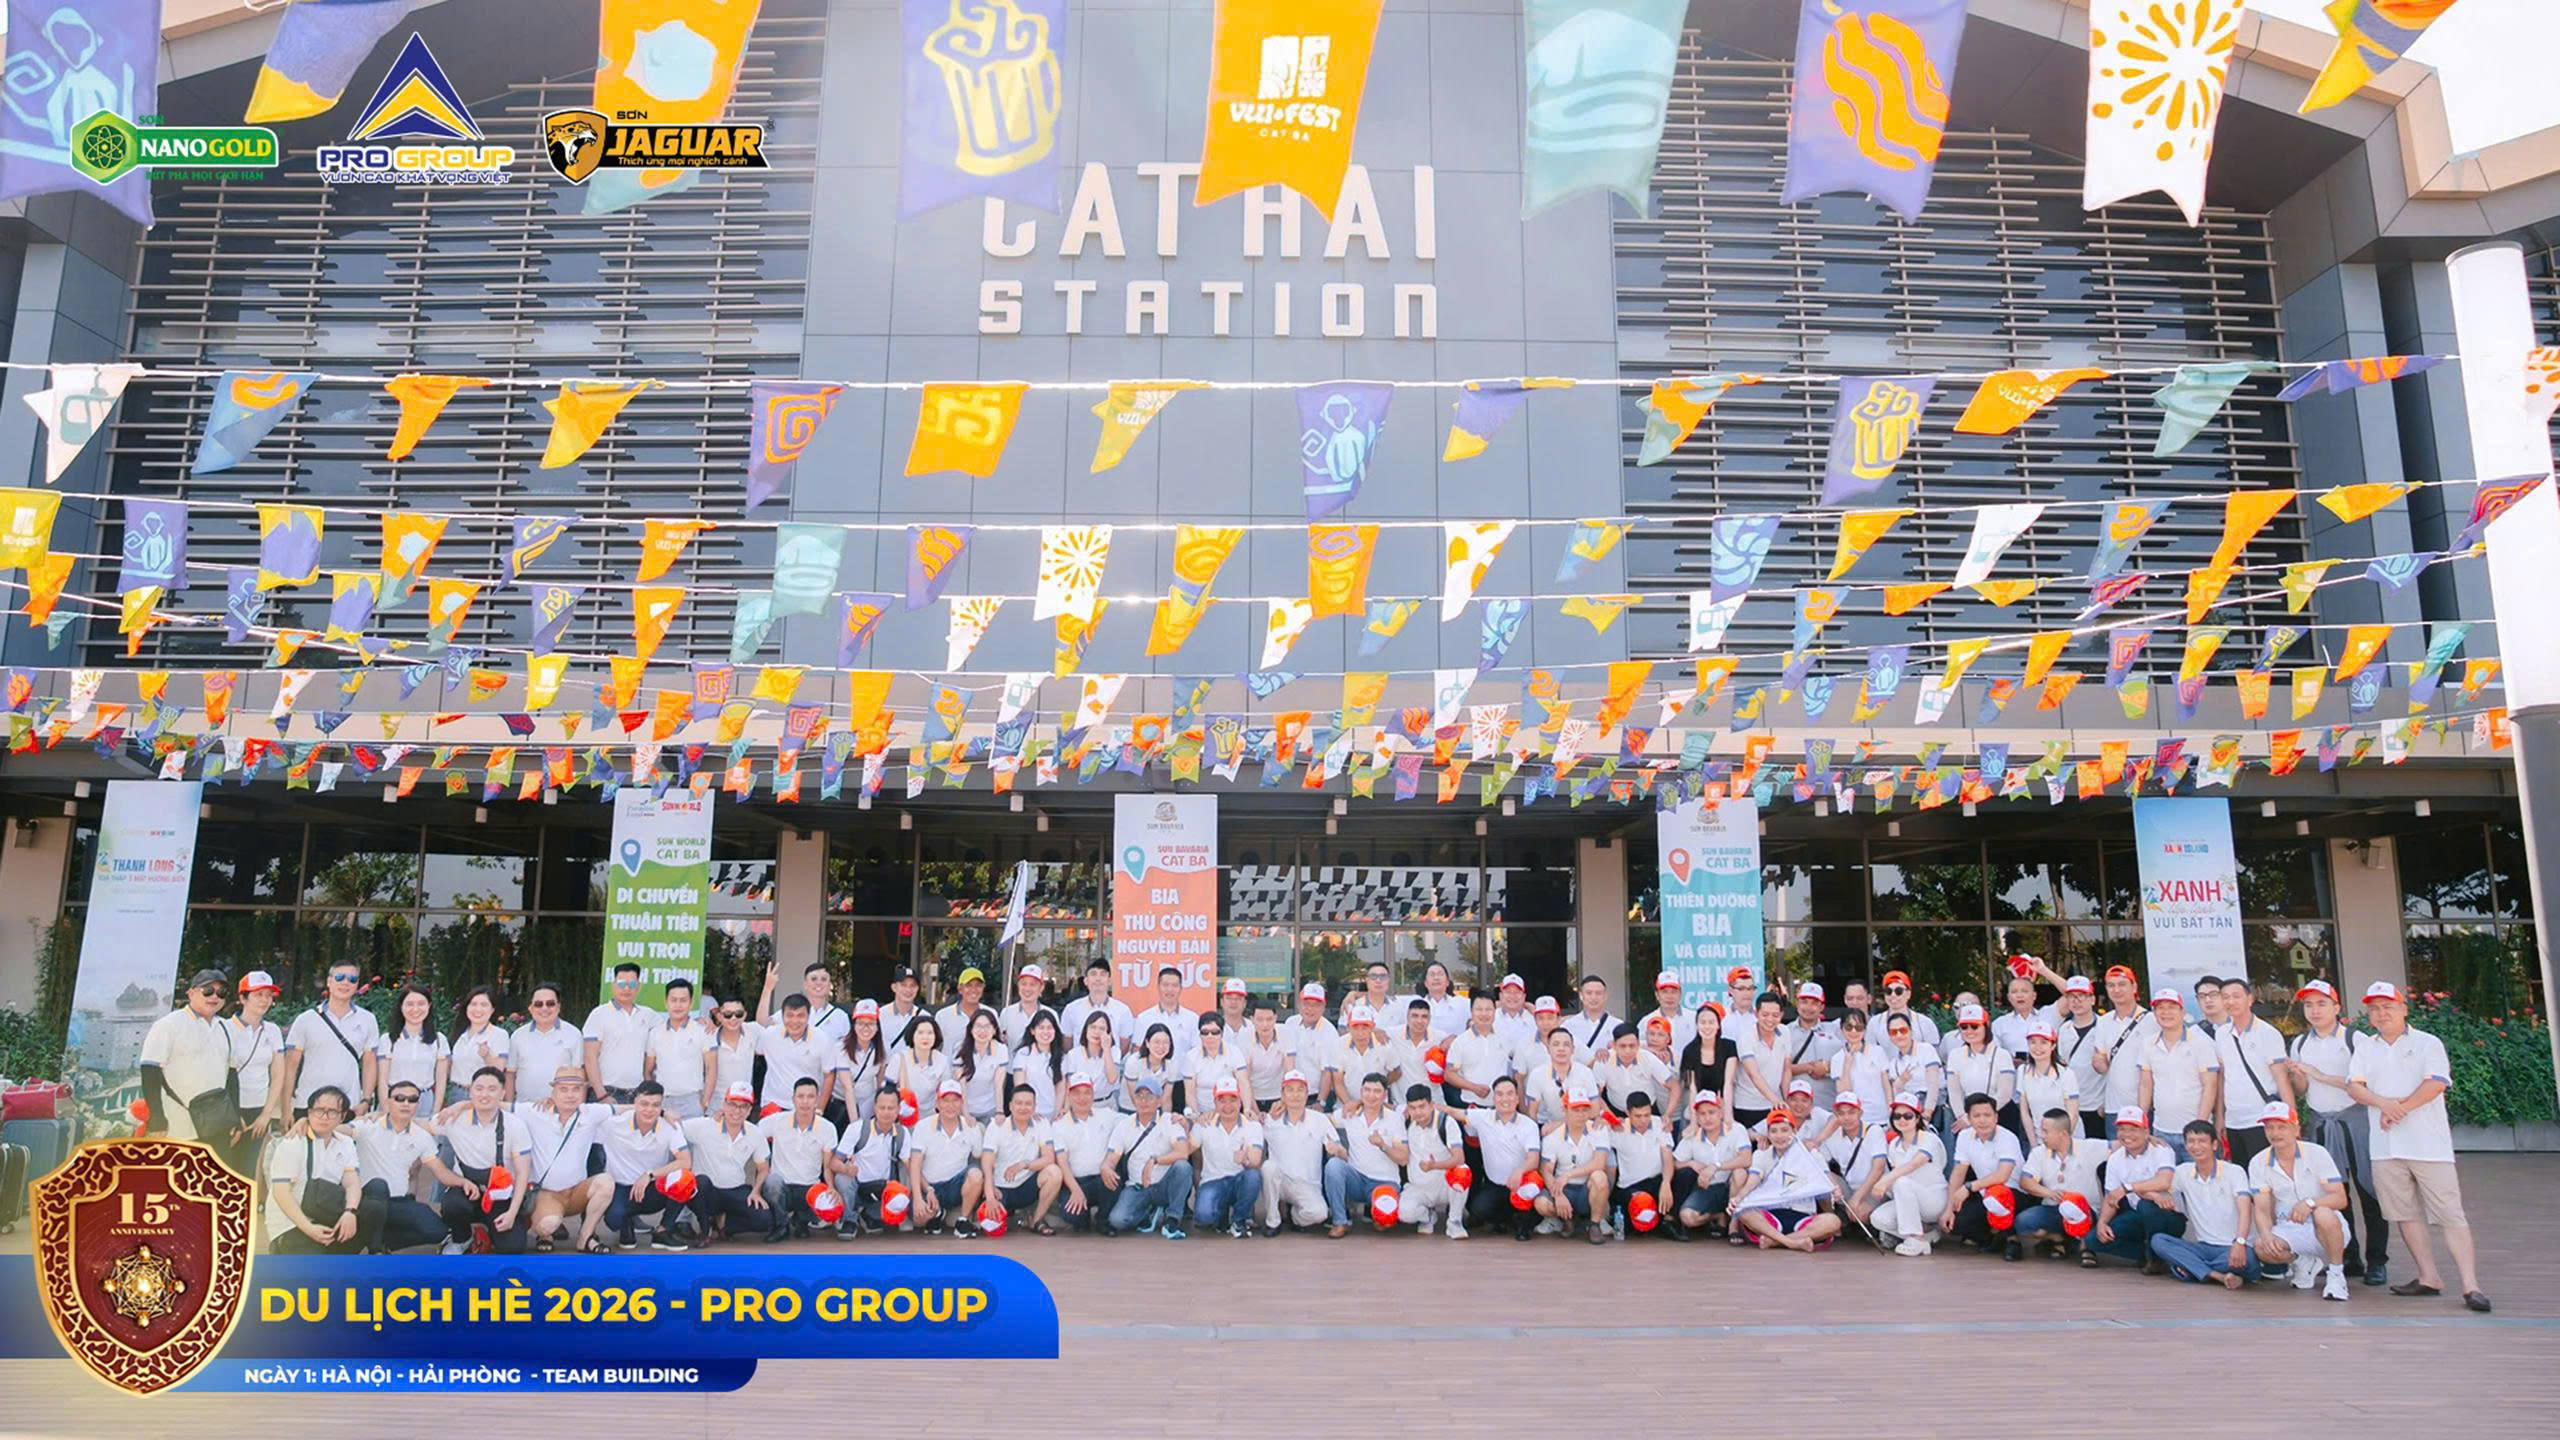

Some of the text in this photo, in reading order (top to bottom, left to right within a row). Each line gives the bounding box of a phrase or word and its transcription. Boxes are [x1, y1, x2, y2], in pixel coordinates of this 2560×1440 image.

[978, 280, 1438, 339] STATION
[112, 858, 146, 873] THANH
[637, 882, 699, 905] CHUYỂN
[1151, 887, 1180, 905] BIA
[1665, 891, 1705, 908] THIÊN
[2158, 879, 2221, 902] XANH
[610, 911, 700, 932] THUẬN TIỆN
[1123, 910, 1208, 932] THỦ CÔNG
[1692, 912, 1733, 937] BIA
[2152, 917, 2176, 929] VUI
[617, 941, 691, 960] VUI TRỌN
[1117, 936, 1176, 954] NGUYÊN
[1180, 936, 1210, 954] BẢN
[1673, 940, 1695, 959] VÀ
[1696, 940, 1728, 959] GIẢI
[1117, 957, 1211, 989] TỪ ỨC
